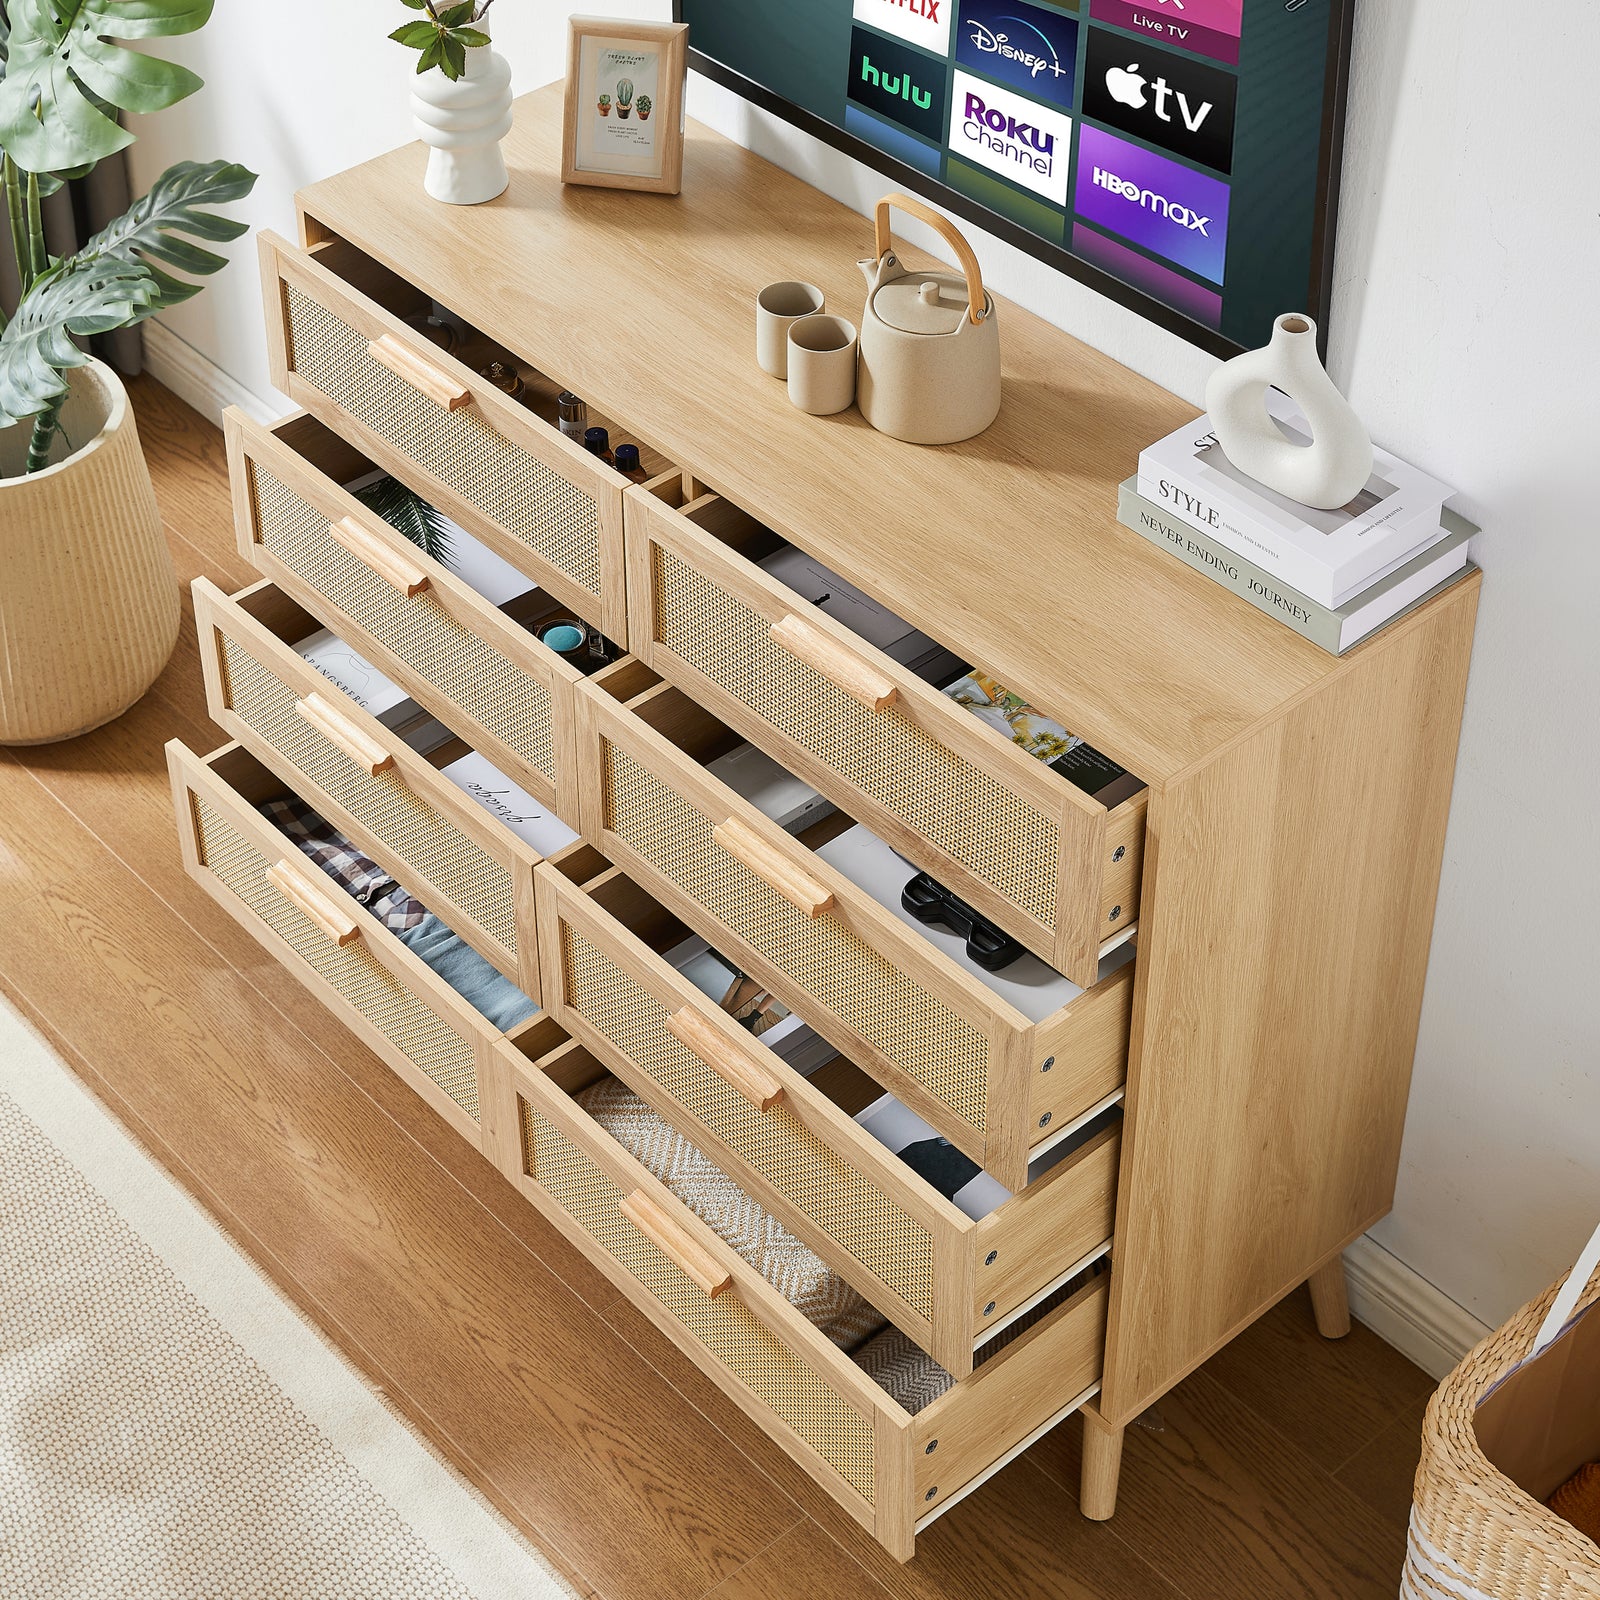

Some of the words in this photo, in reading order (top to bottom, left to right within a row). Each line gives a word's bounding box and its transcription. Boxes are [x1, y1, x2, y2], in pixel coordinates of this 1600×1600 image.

[1132, 13, 1163, 32] Live
[1167, 23, 1190, 41] TV
[861, 55, 932, 110] hulu
[1151, 76, 1213, 133] tv
[963, 121, 1053, 178] Channel
[1193, 430, 1220, 452] ST
[1158, 478, 1220, 530] STYLE
[1139, 511, 1184, 548] NEVER
[1186, 540, 1239, 580] ENDING
[1247, 577, 1312, 625] JOURNEY
